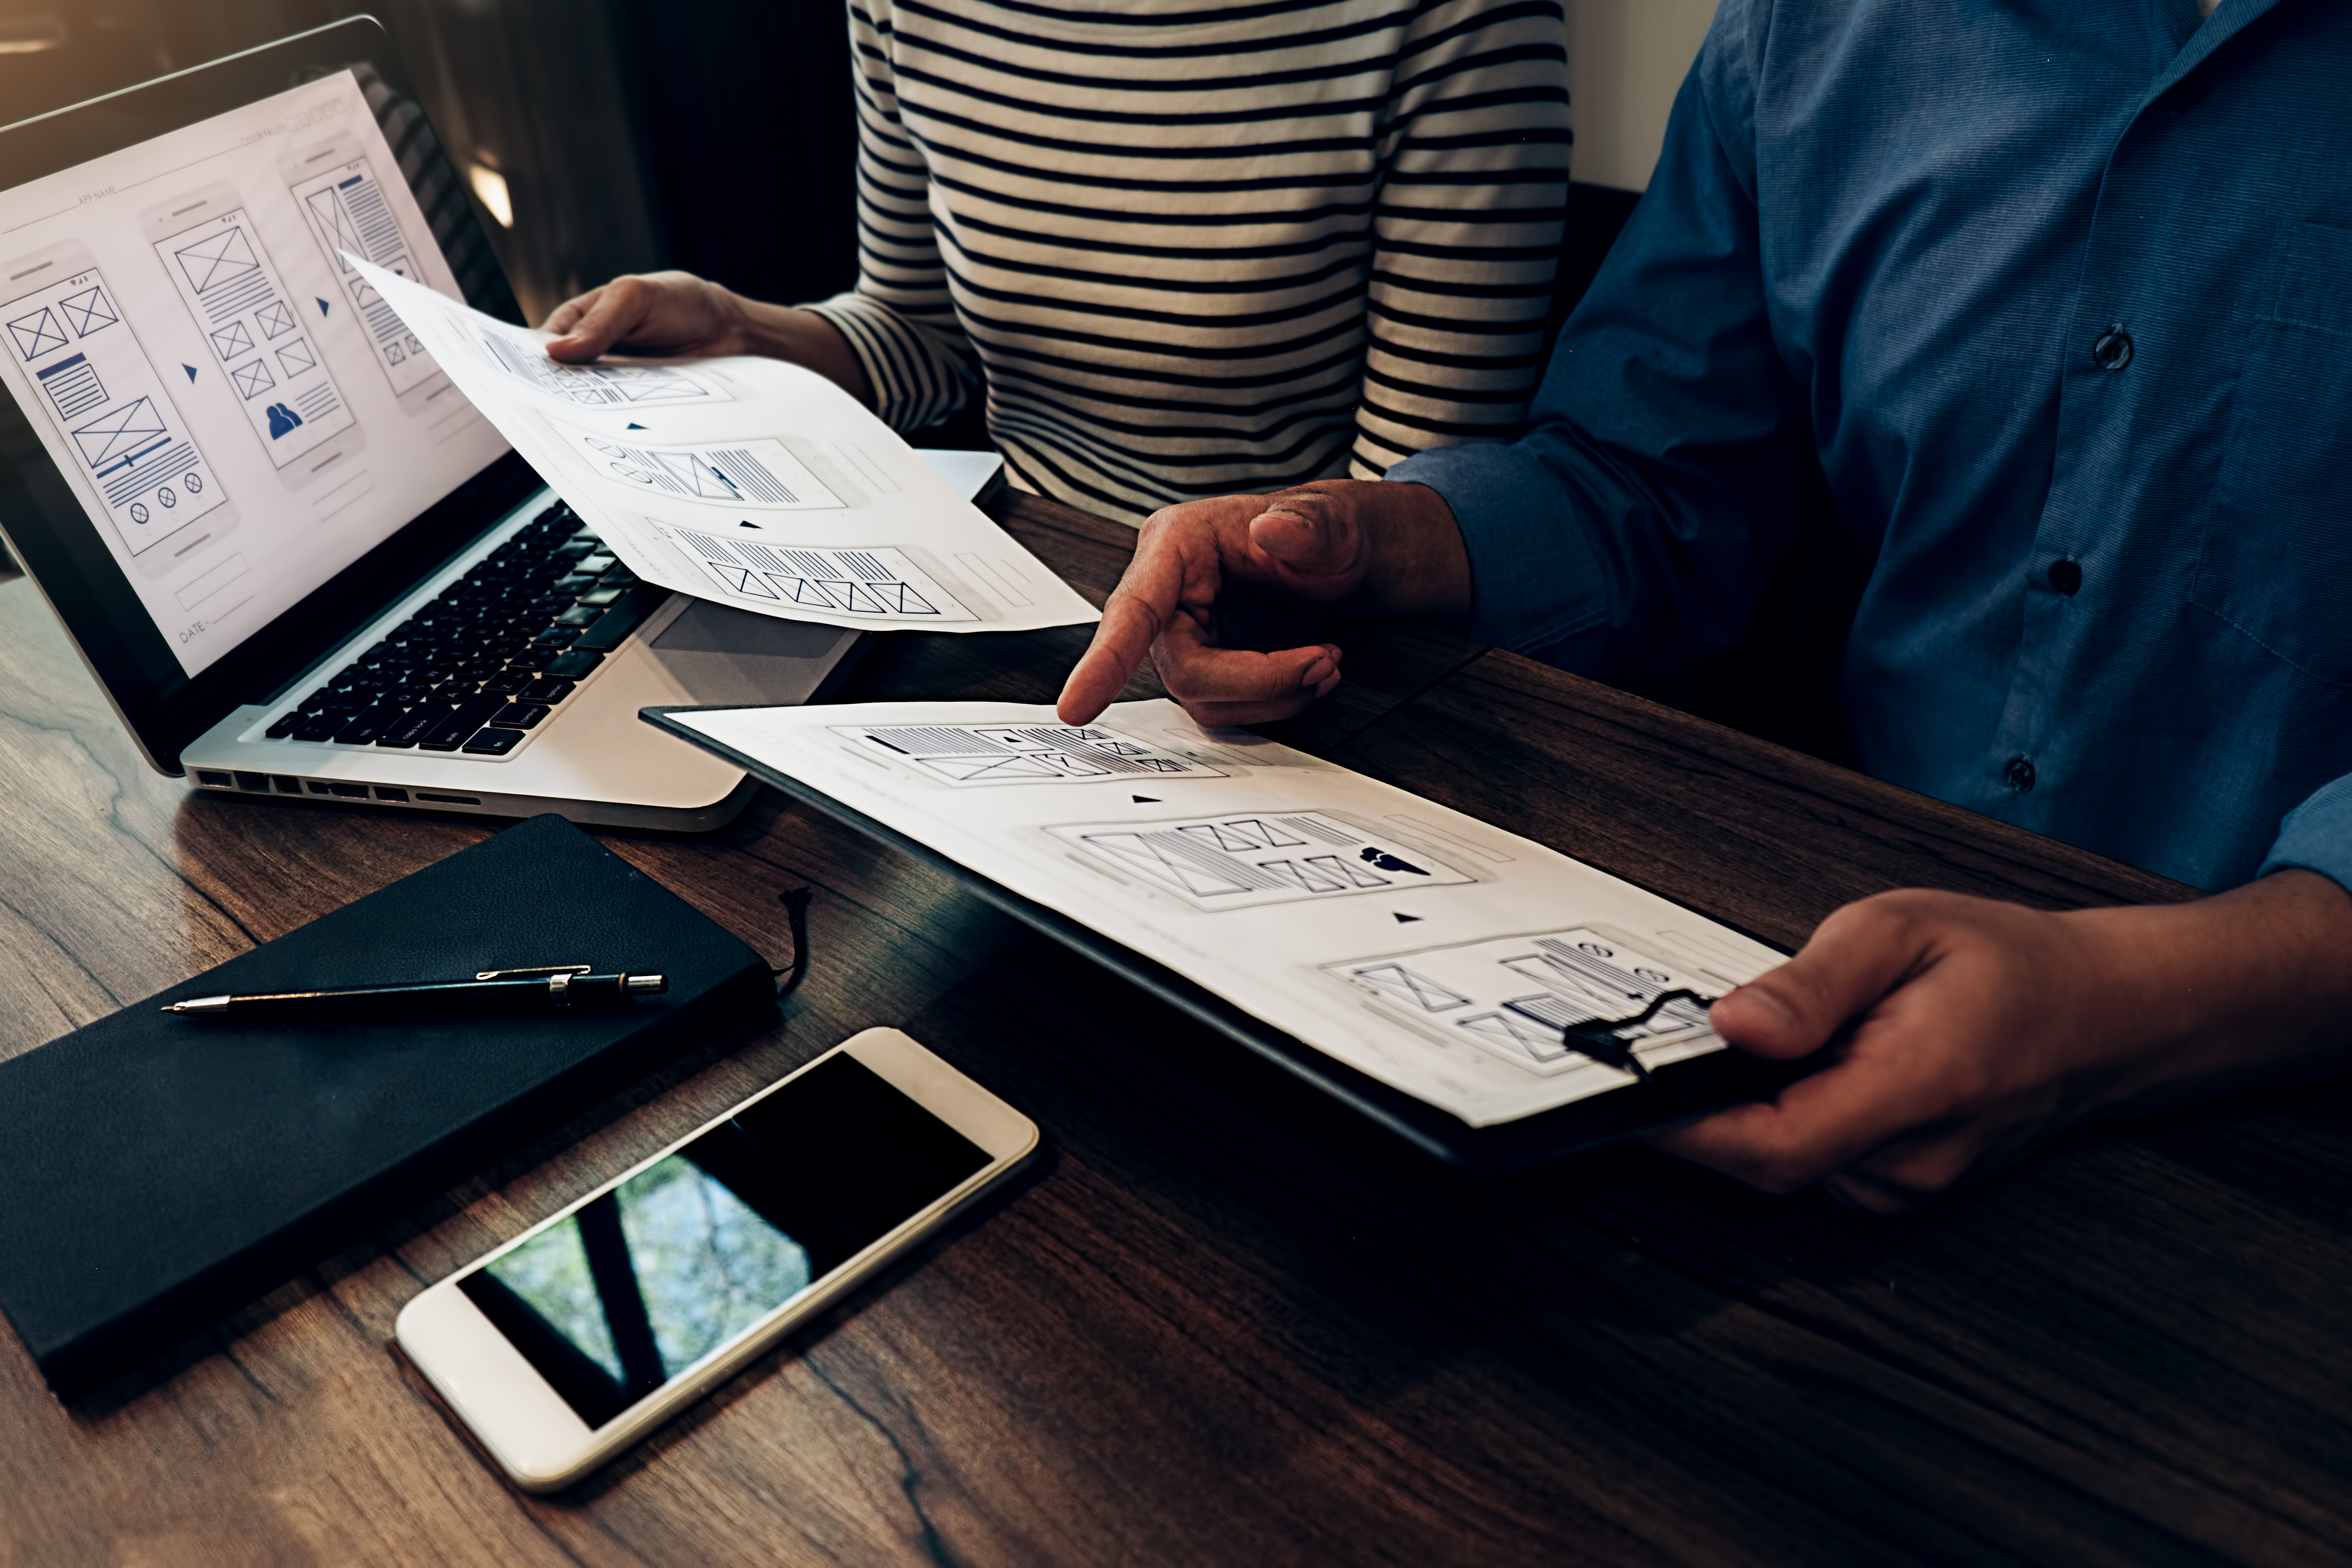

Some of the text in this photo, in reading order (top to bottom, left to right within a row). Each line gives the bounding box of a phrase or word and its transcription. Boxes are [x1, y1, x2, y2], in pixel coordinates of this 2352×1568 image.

[78, 185, 117, 206] APP NAME
[546, 684, 564, 698] option
[520, 708, 539, 723] control
[359, 728, 372, 736] tab
[403, 719, 429, 739] caps lock
[445, 732, 460, 742] shift
